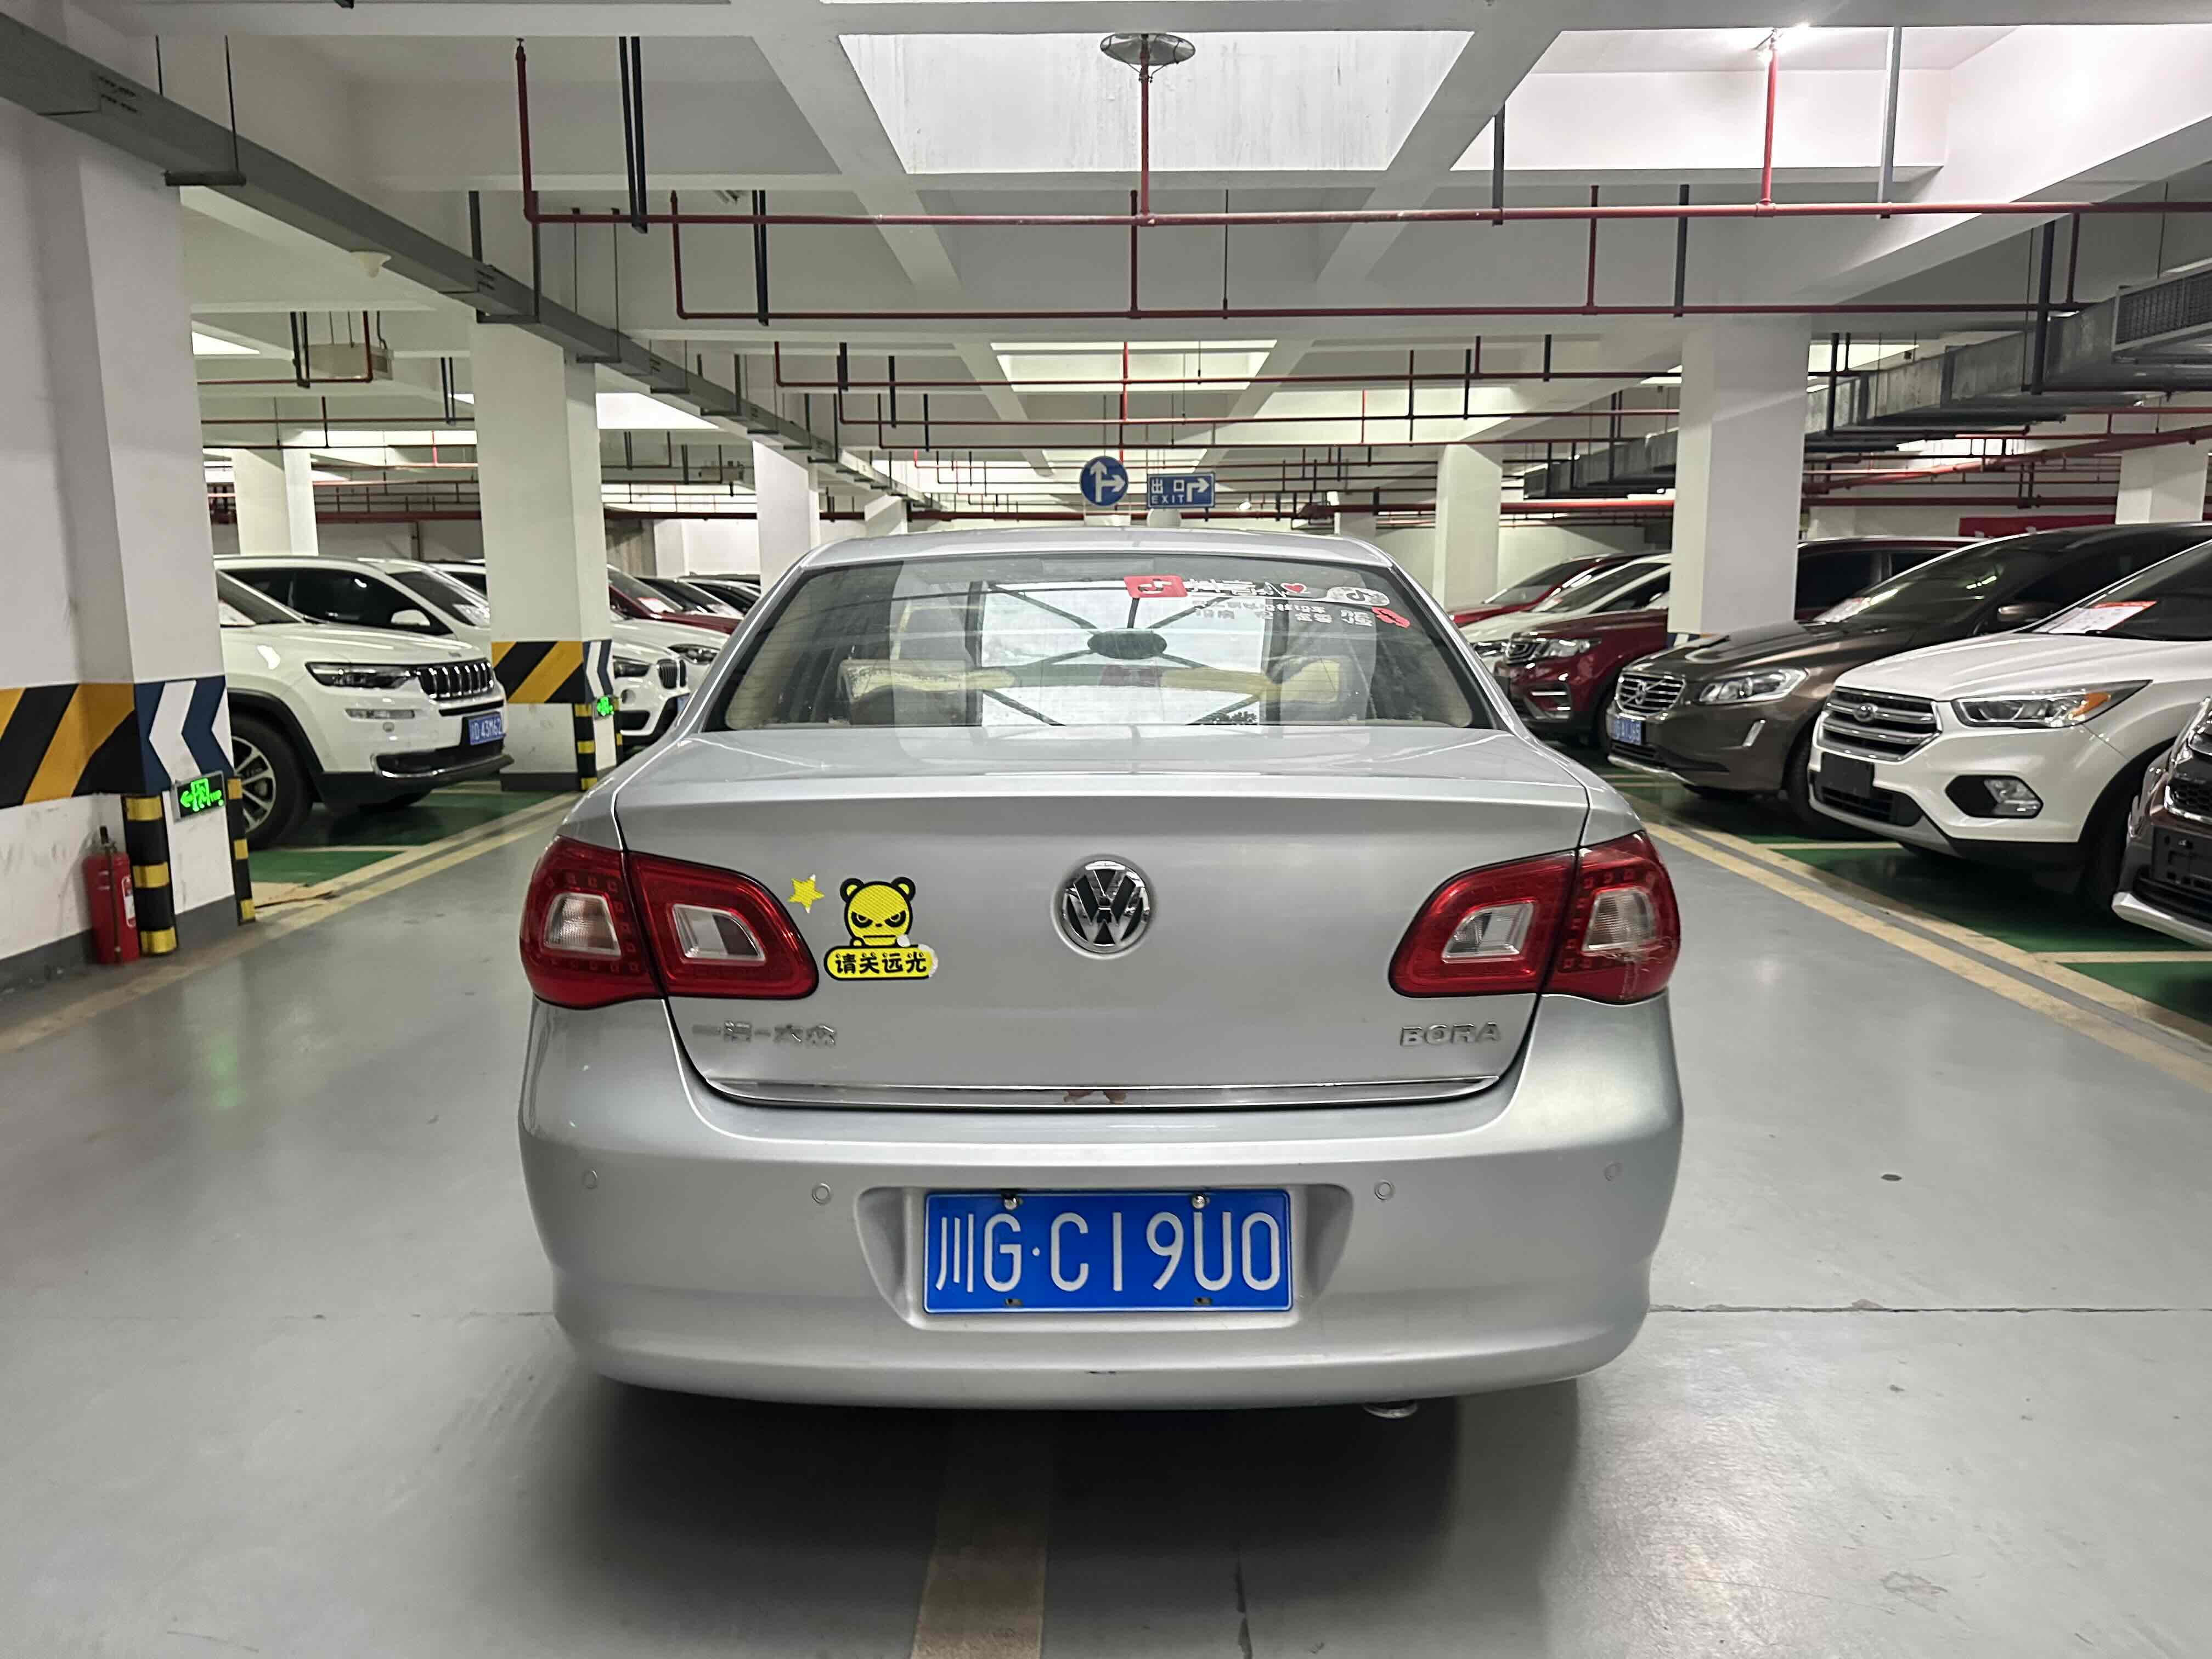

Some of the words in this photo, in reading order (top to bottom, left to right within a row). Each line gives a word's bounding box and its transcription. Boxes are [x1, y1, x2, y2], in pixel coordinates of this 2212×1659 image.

[1152, 478, 1185, 493] 出口
[1152, 495, 1184, 504] EXIT
[835, 952, 927, 974] 请关远光
[1400, 1022, 1502, 1046] BORA
